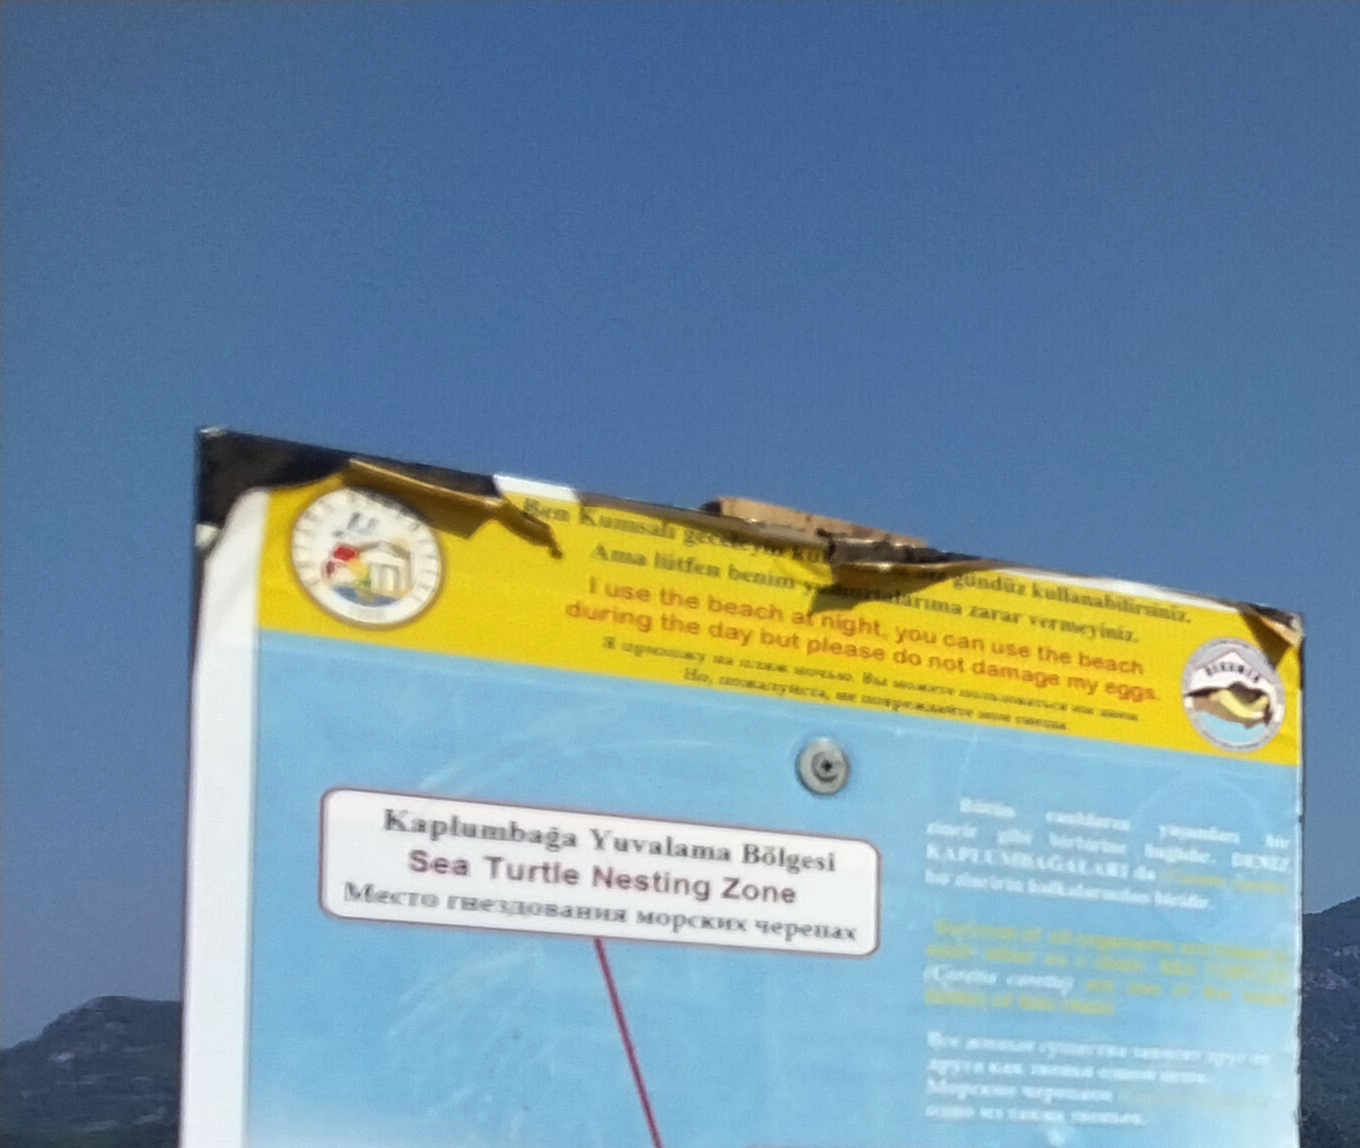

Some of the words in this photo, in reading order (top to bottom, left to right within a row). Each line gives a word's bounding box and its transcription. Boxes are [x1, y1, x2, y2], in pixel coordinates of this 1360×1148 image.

[591, 543, 648, 568] Ama
[654, 551, 720, 578] lütfen
[728, 563, 795, 590] benim
[967, 604, 1022, 627] zarar
[565, 600, 653, 634] during
[661, 611, 701, 635] the
[708, 618, 755, 647] day
[760, 626, 800, 650] but
[806, 635, 885, 663] please
[893, 647, 922, 667] do
[929, 652, 964, 674] not
[971, 658, 1060, 689] damage
[1066, 674, 1099, 696] my
[588, 574, 597, 595] I
[604, 581, 650, 601] use
[659, 586, 700, 610] the
[707, 593, 783, 622] beach
[791, 607, 813, 627] at
[820, 613, 888, 639] night,
[895, 623, 938, 648] you
[944, 630, 985, 652] can
[991, 638, 1030, 659] use
[1037, 639, 1072, 665] the
[1079, 648, 1144, 676] beach
[383, 808, 578, 852] Kaplumbağa
[590, 827, 732, 863] Yuvalama
[740, 842, 836, 875] Bölgesi
[408, 849, 471, 877] Sea
[483, 855, 580, 886] Turtle
[592, 864, 711, 902] Nesting
[720, 876, 798, 904] Zone
[343, 880, 441, 910] Место
[446, 893, 628, 925] гнездования
[636, 909, 748, 934] морских
[754, 917, 858, 943] черепах
